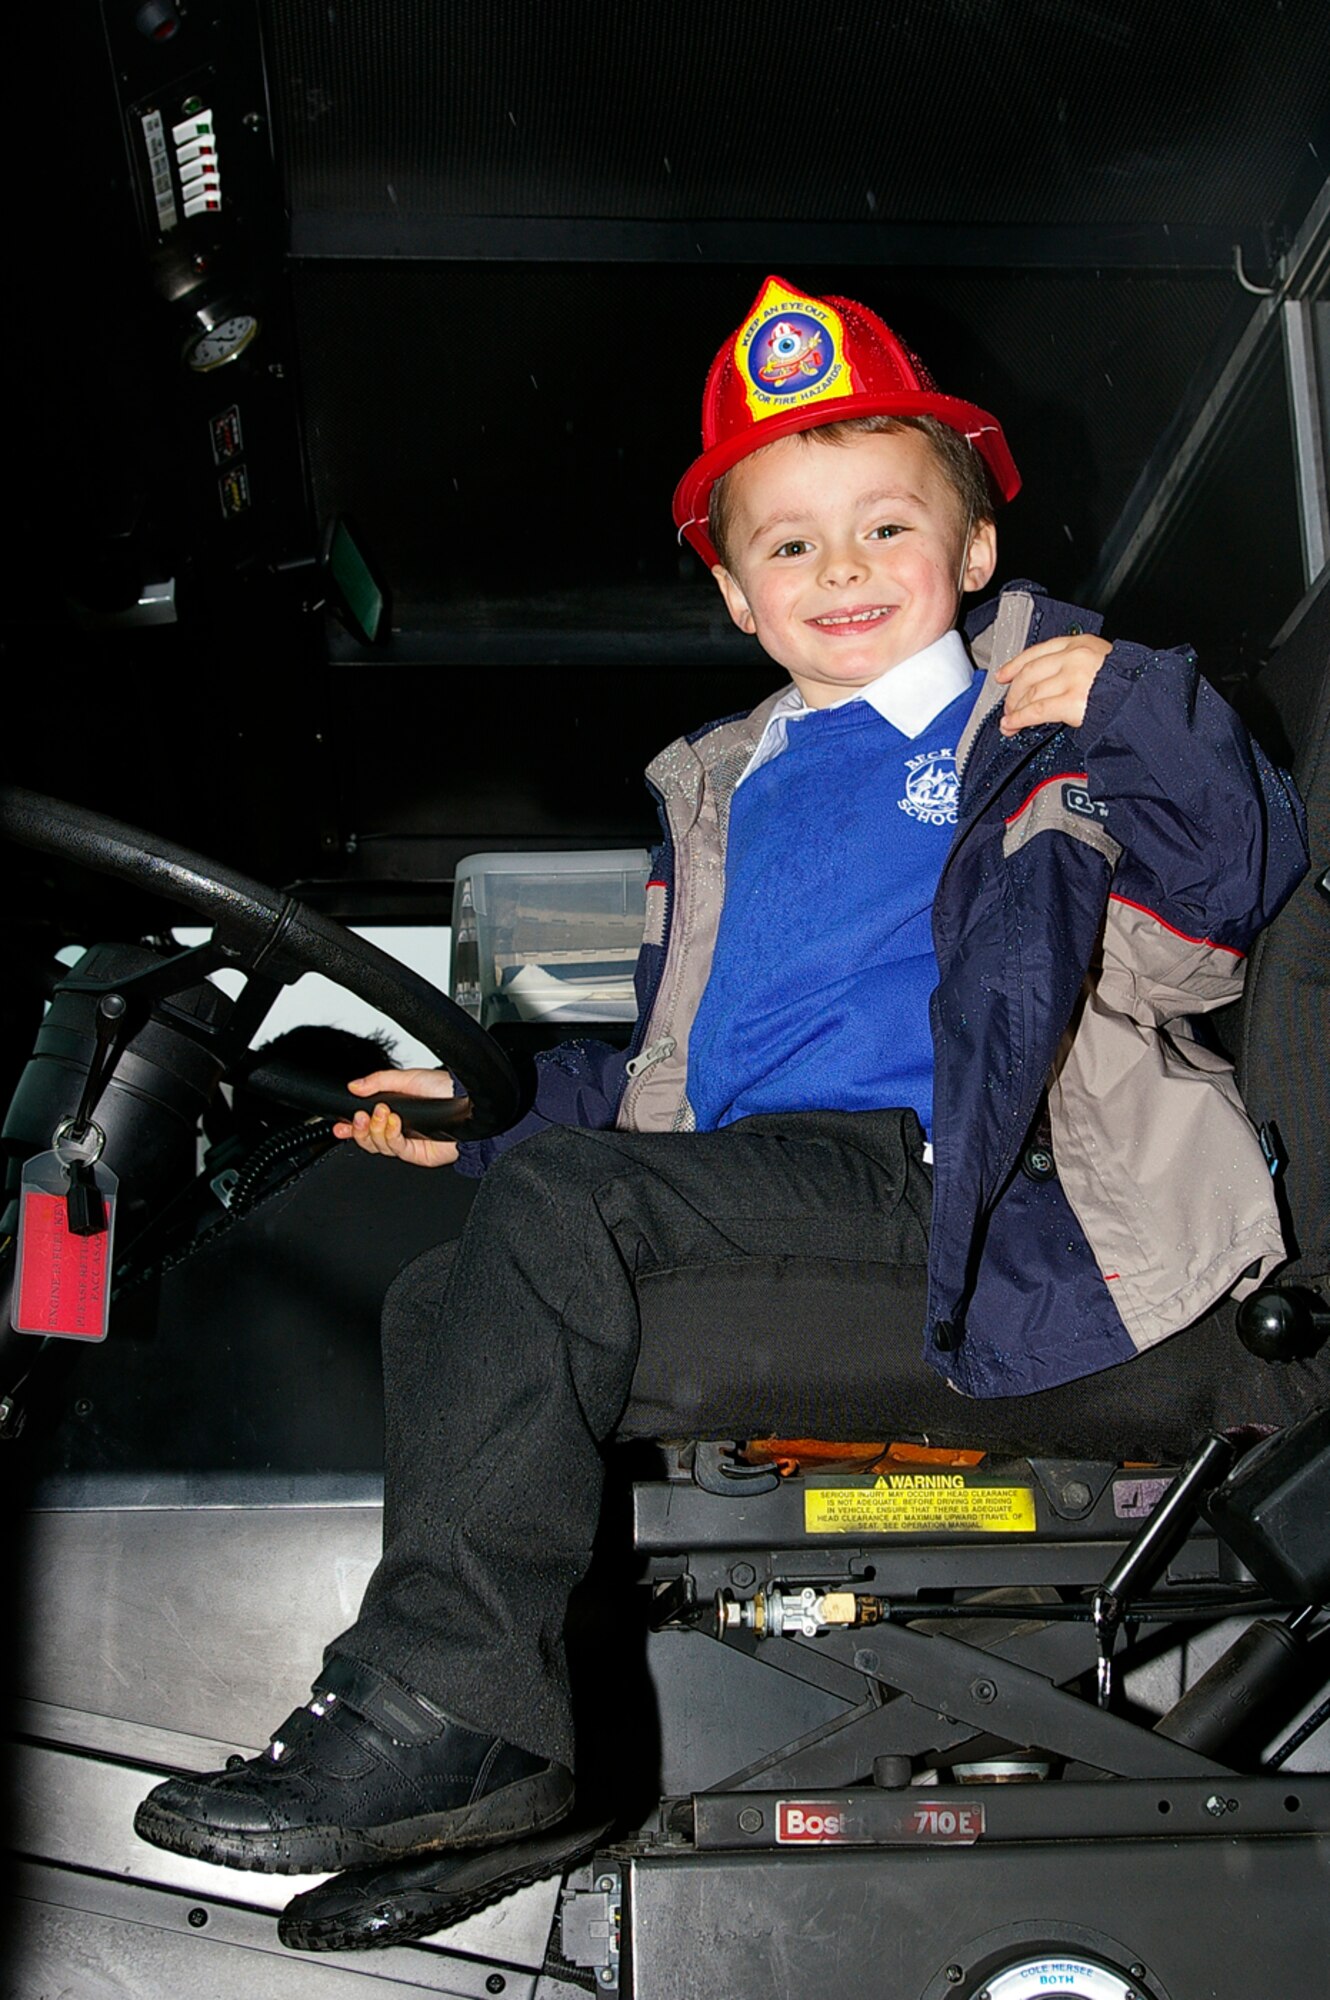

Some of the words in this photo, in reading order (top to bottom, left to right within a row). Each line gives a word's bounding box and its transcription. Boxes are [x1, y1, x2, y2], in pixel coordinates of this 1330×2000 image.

[742, 318, 760, 347] KEEP
[764, 305, 779, 318] AN
[781, 302, 804, 310] EYE
[804, 304, 828, 320] OUT
[752, 389, 771, 404] FOR
[774, 396, 797, 406] FIRE
[800, 364, 842, 400] HAZARDS
[897, 798, 959, 826] SCHOO
[54, 1202, 64, 1226] KEY
[52, 1228, 63, 1260] FUEL
[80, 1237, 89, 1278] RETUR
[48, 1278, 60, 1326] ENGINE
[76, 1281, 87, 1328] PLEASE
[820, 1491, 855, 1499] SERIOUS
[857, 1491, 885, 1499] INJURY
[971, 1490, 1018, 1498] CLEARANCE
[889, 1474, 964, 1489] WARNING
[786, 1809, 848, 1835] Bost
[1020, 1964, 1048, 1978] COLE
[1052, 1964, 1094, 1978] HERSEE
[1040, 1975, 1074, 1985] BOTH
